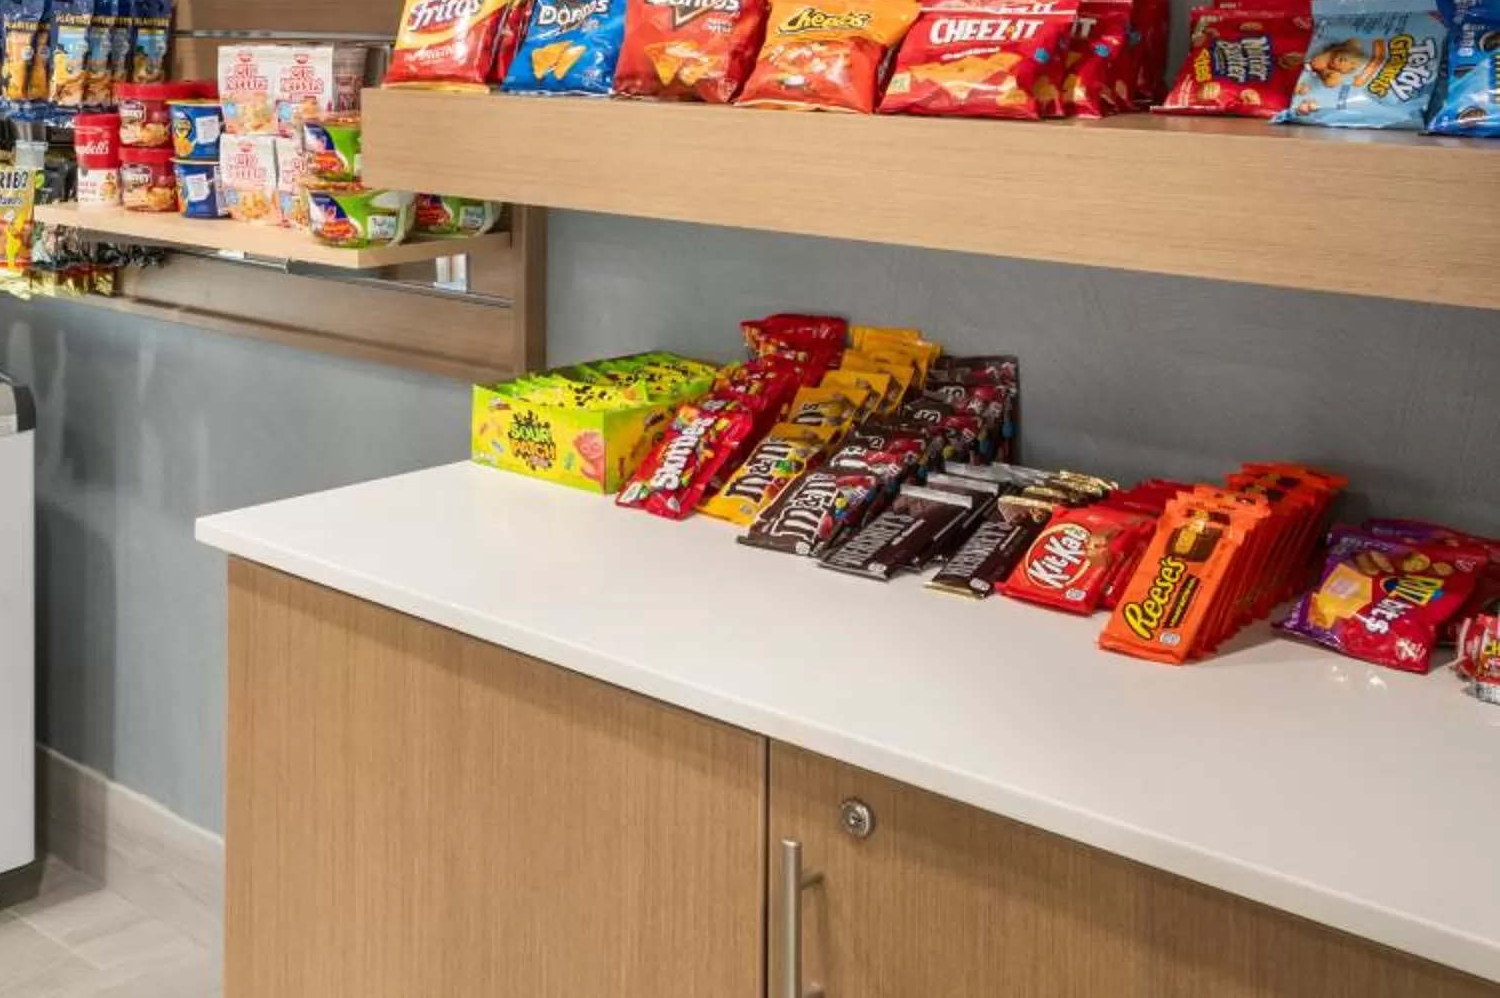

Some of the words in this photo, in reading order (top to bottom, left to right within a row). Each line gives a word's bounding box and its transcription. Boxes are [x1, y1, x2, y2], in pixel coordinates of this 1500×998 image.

[1216, 39, 1246, 83] Butter
[1240, 35, 1271, 82] Nutter
[1390, 35, 1437, 102] Teddy
[652, 416, 716, 491] Skittles
[826, 510, 917, 567] HERSHEY'S
[942, 520, 1010, 577] HERSHEY'S
[1124, 554, 1187, 641] Reese's
